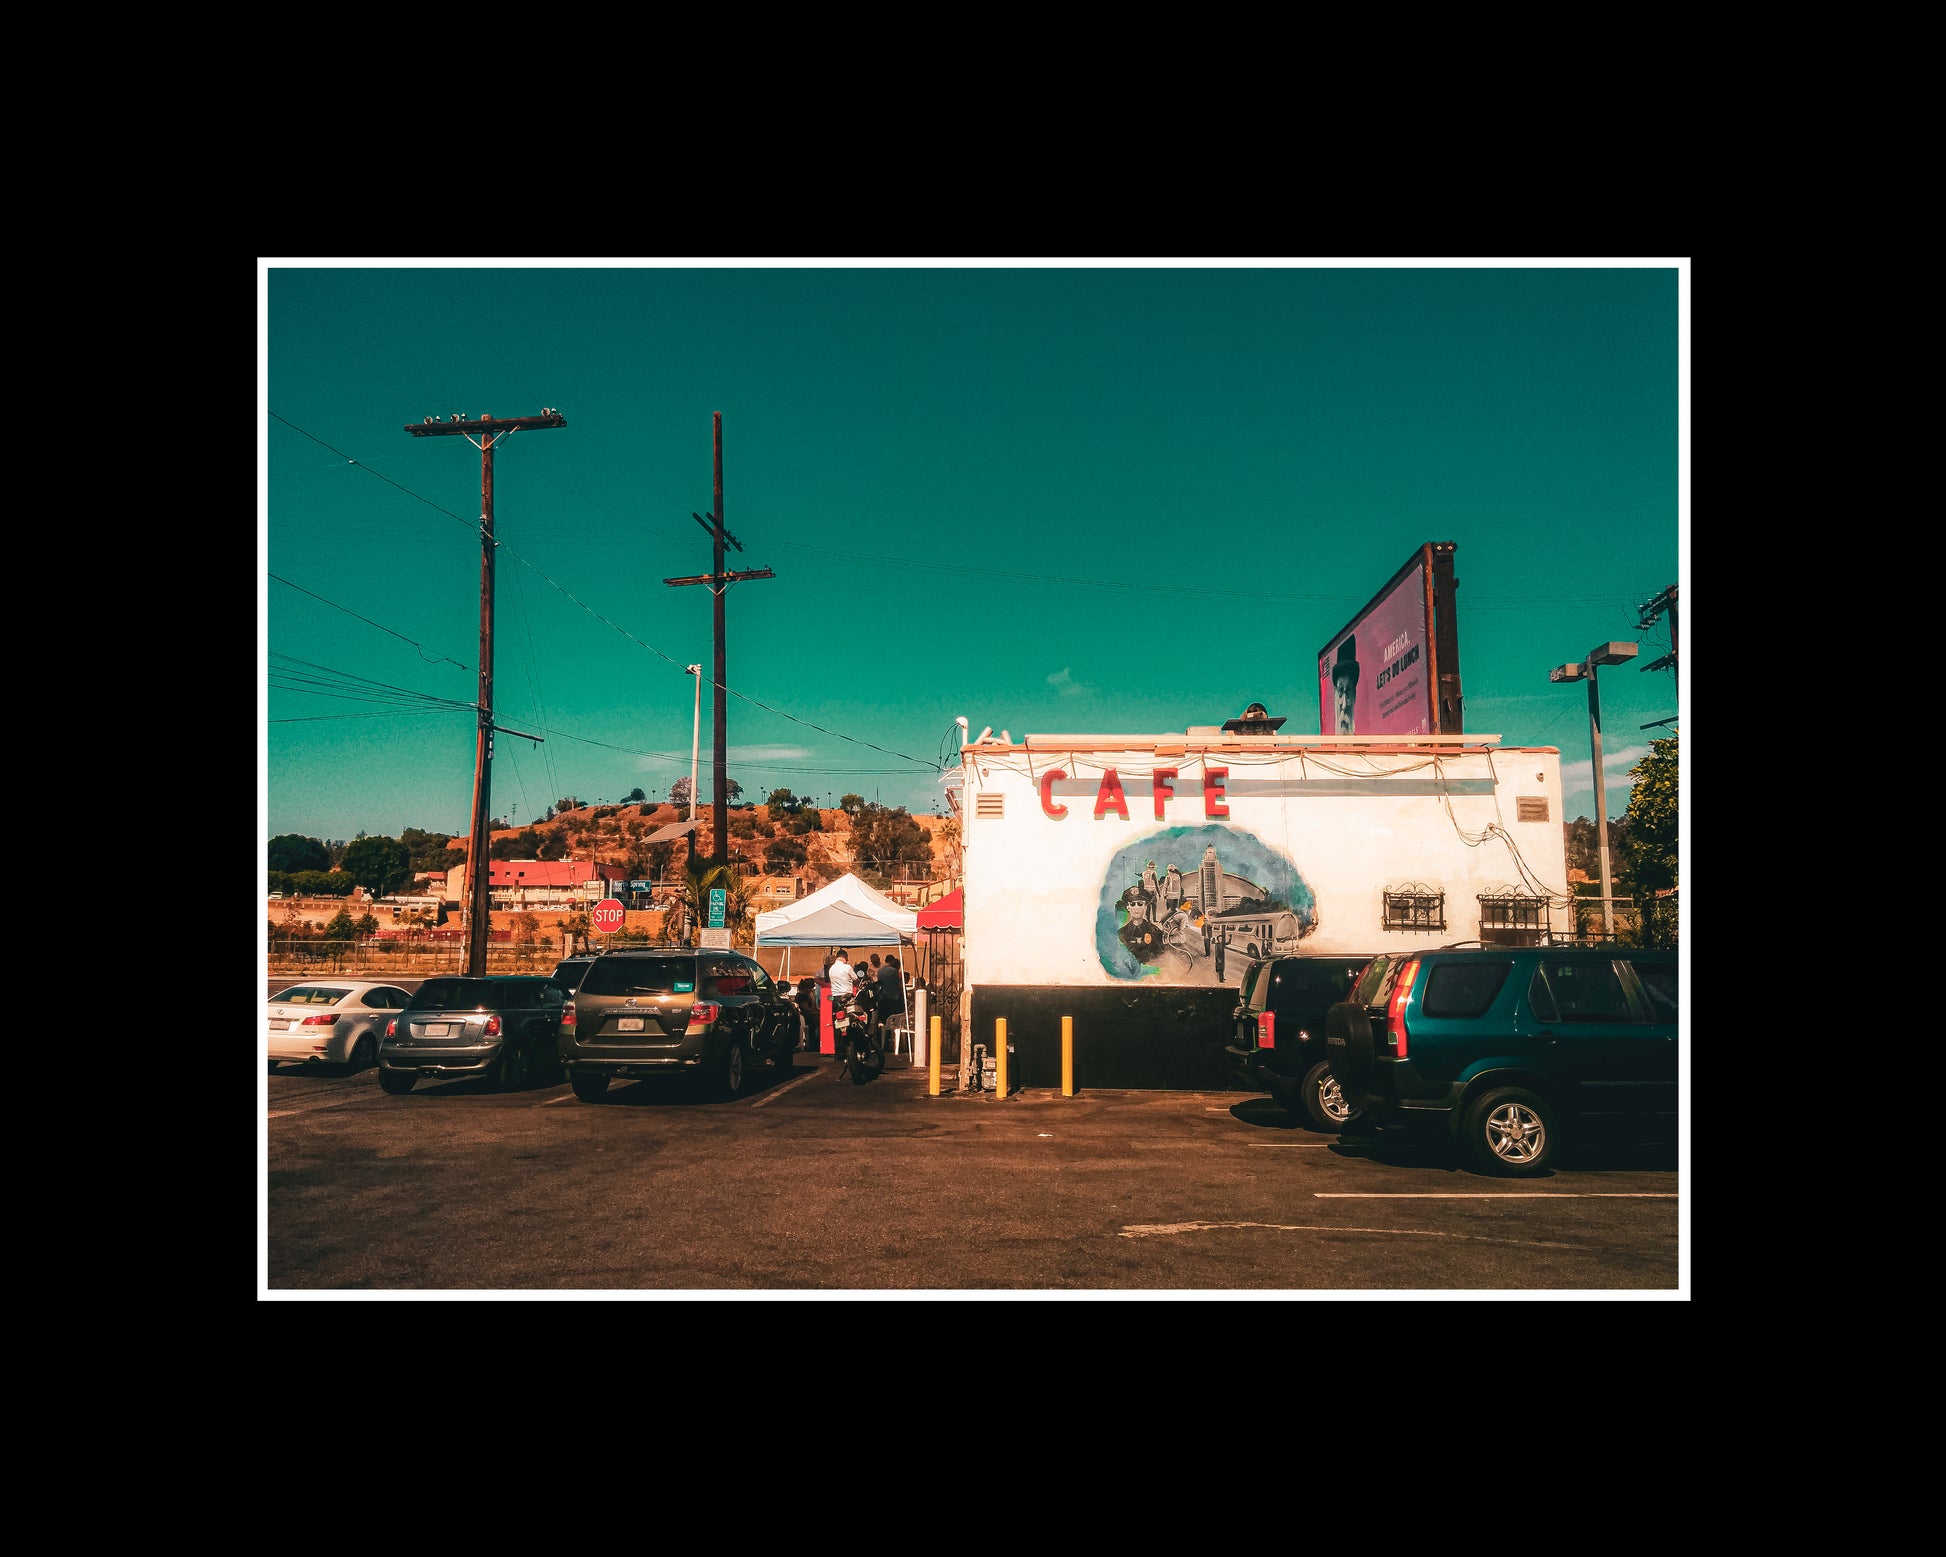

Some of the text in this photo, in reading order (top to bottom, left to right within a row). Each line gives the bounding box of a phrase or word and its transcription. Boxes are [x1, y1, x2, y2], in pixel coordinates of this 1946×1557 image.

[1383, 631, 1411, 663] AMERICA,
[1376, 644, 1419, 690] LET'S DO LUNCH
[1041, 767, 1230, 820] CAFE
[630, 881, 646, 889] Spring
[595, 909, 624, 923] STOP
